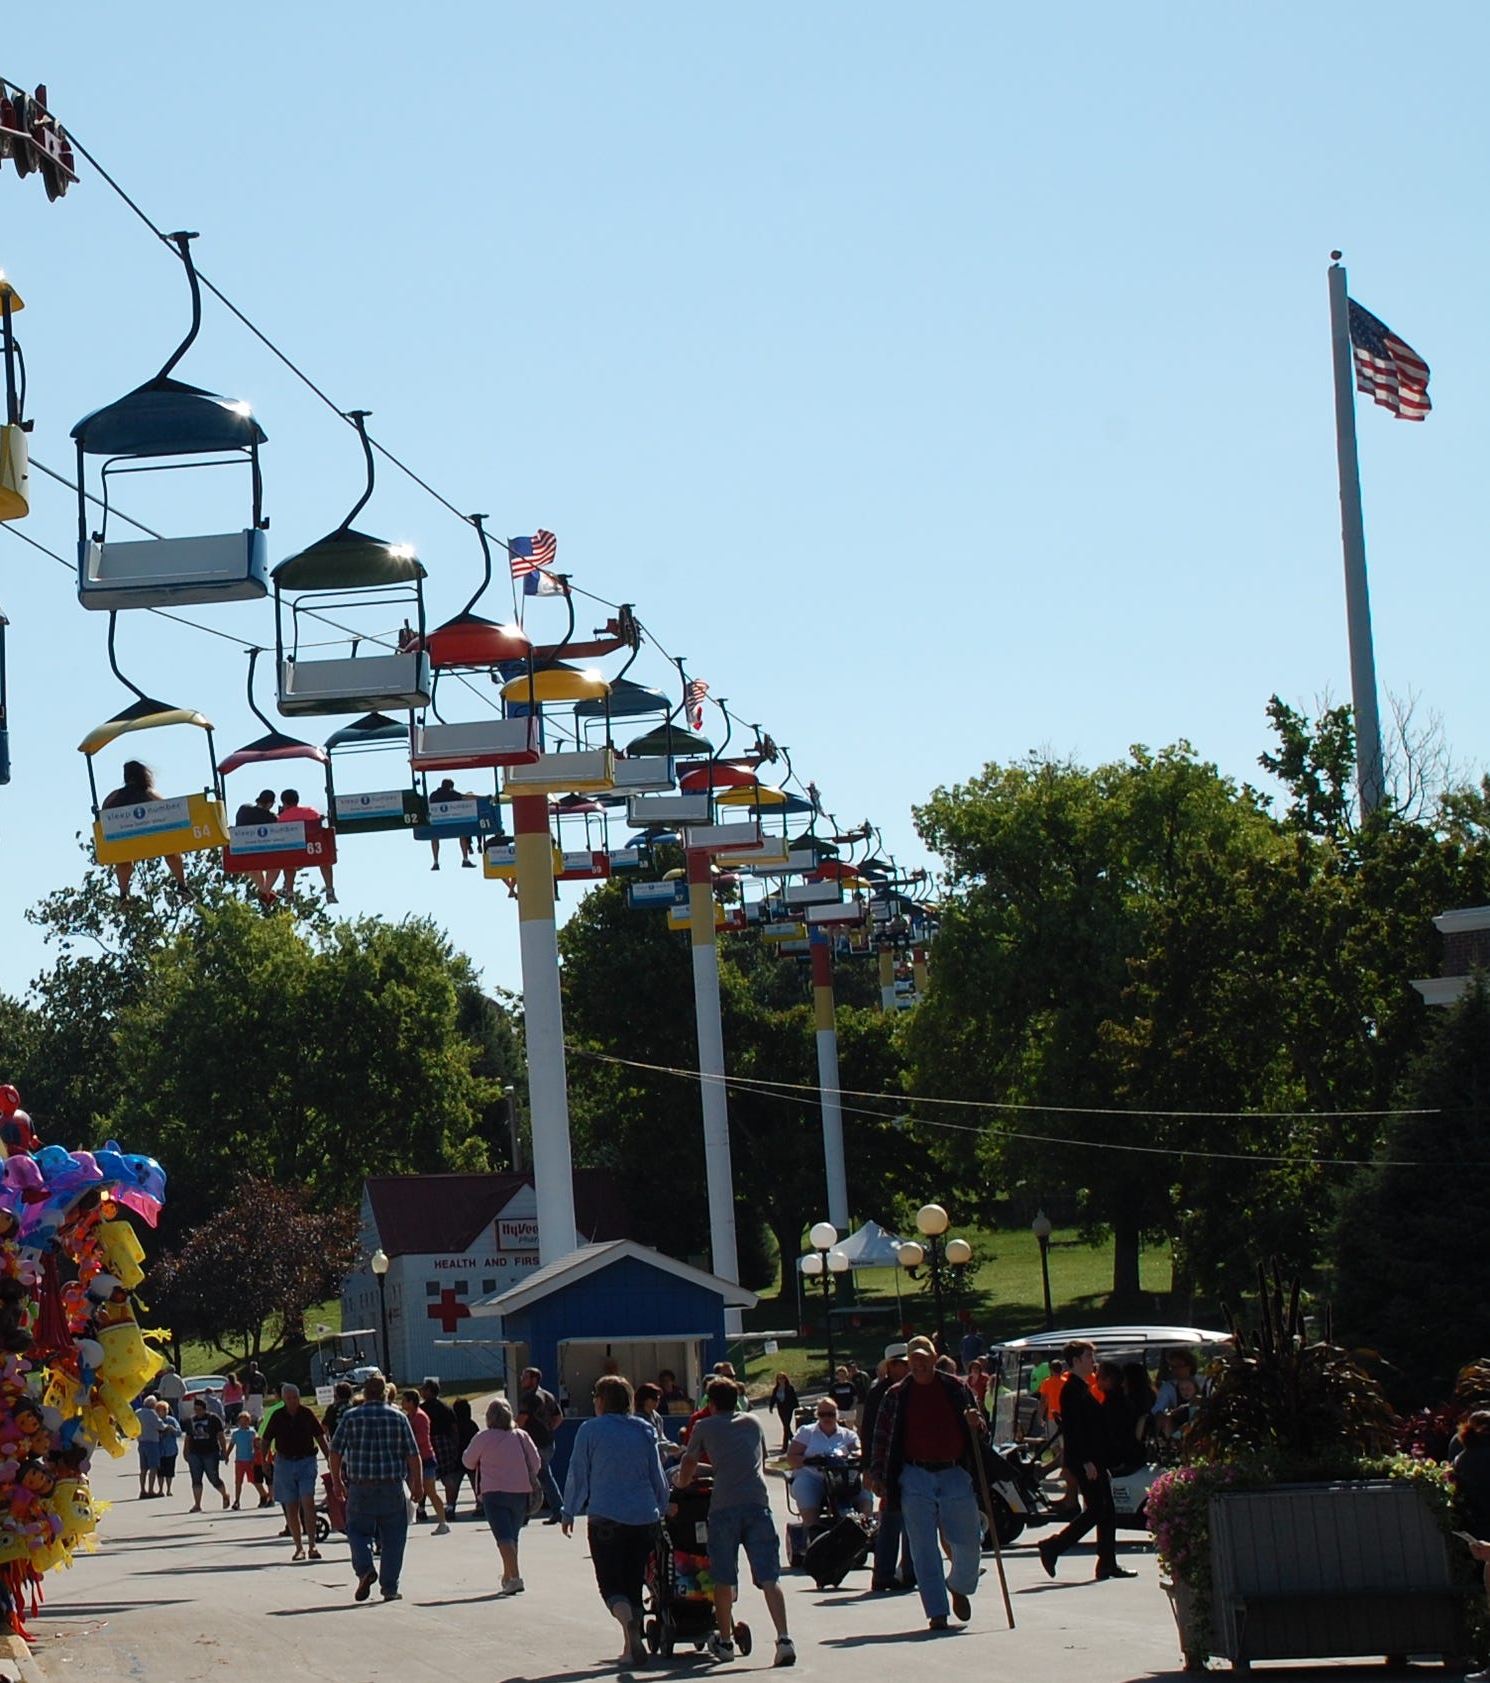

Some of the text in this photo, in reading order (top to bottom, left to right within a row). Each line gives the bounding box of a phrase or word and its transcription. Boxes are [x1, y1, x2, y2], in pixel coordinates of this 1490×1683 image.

[404, 813, 419, 824] 62
[193, 825, 212, 839] 64
[306, 841, 323, 855] 63
[434, 1256, 540, 1269] HEALTH AND FIRS
